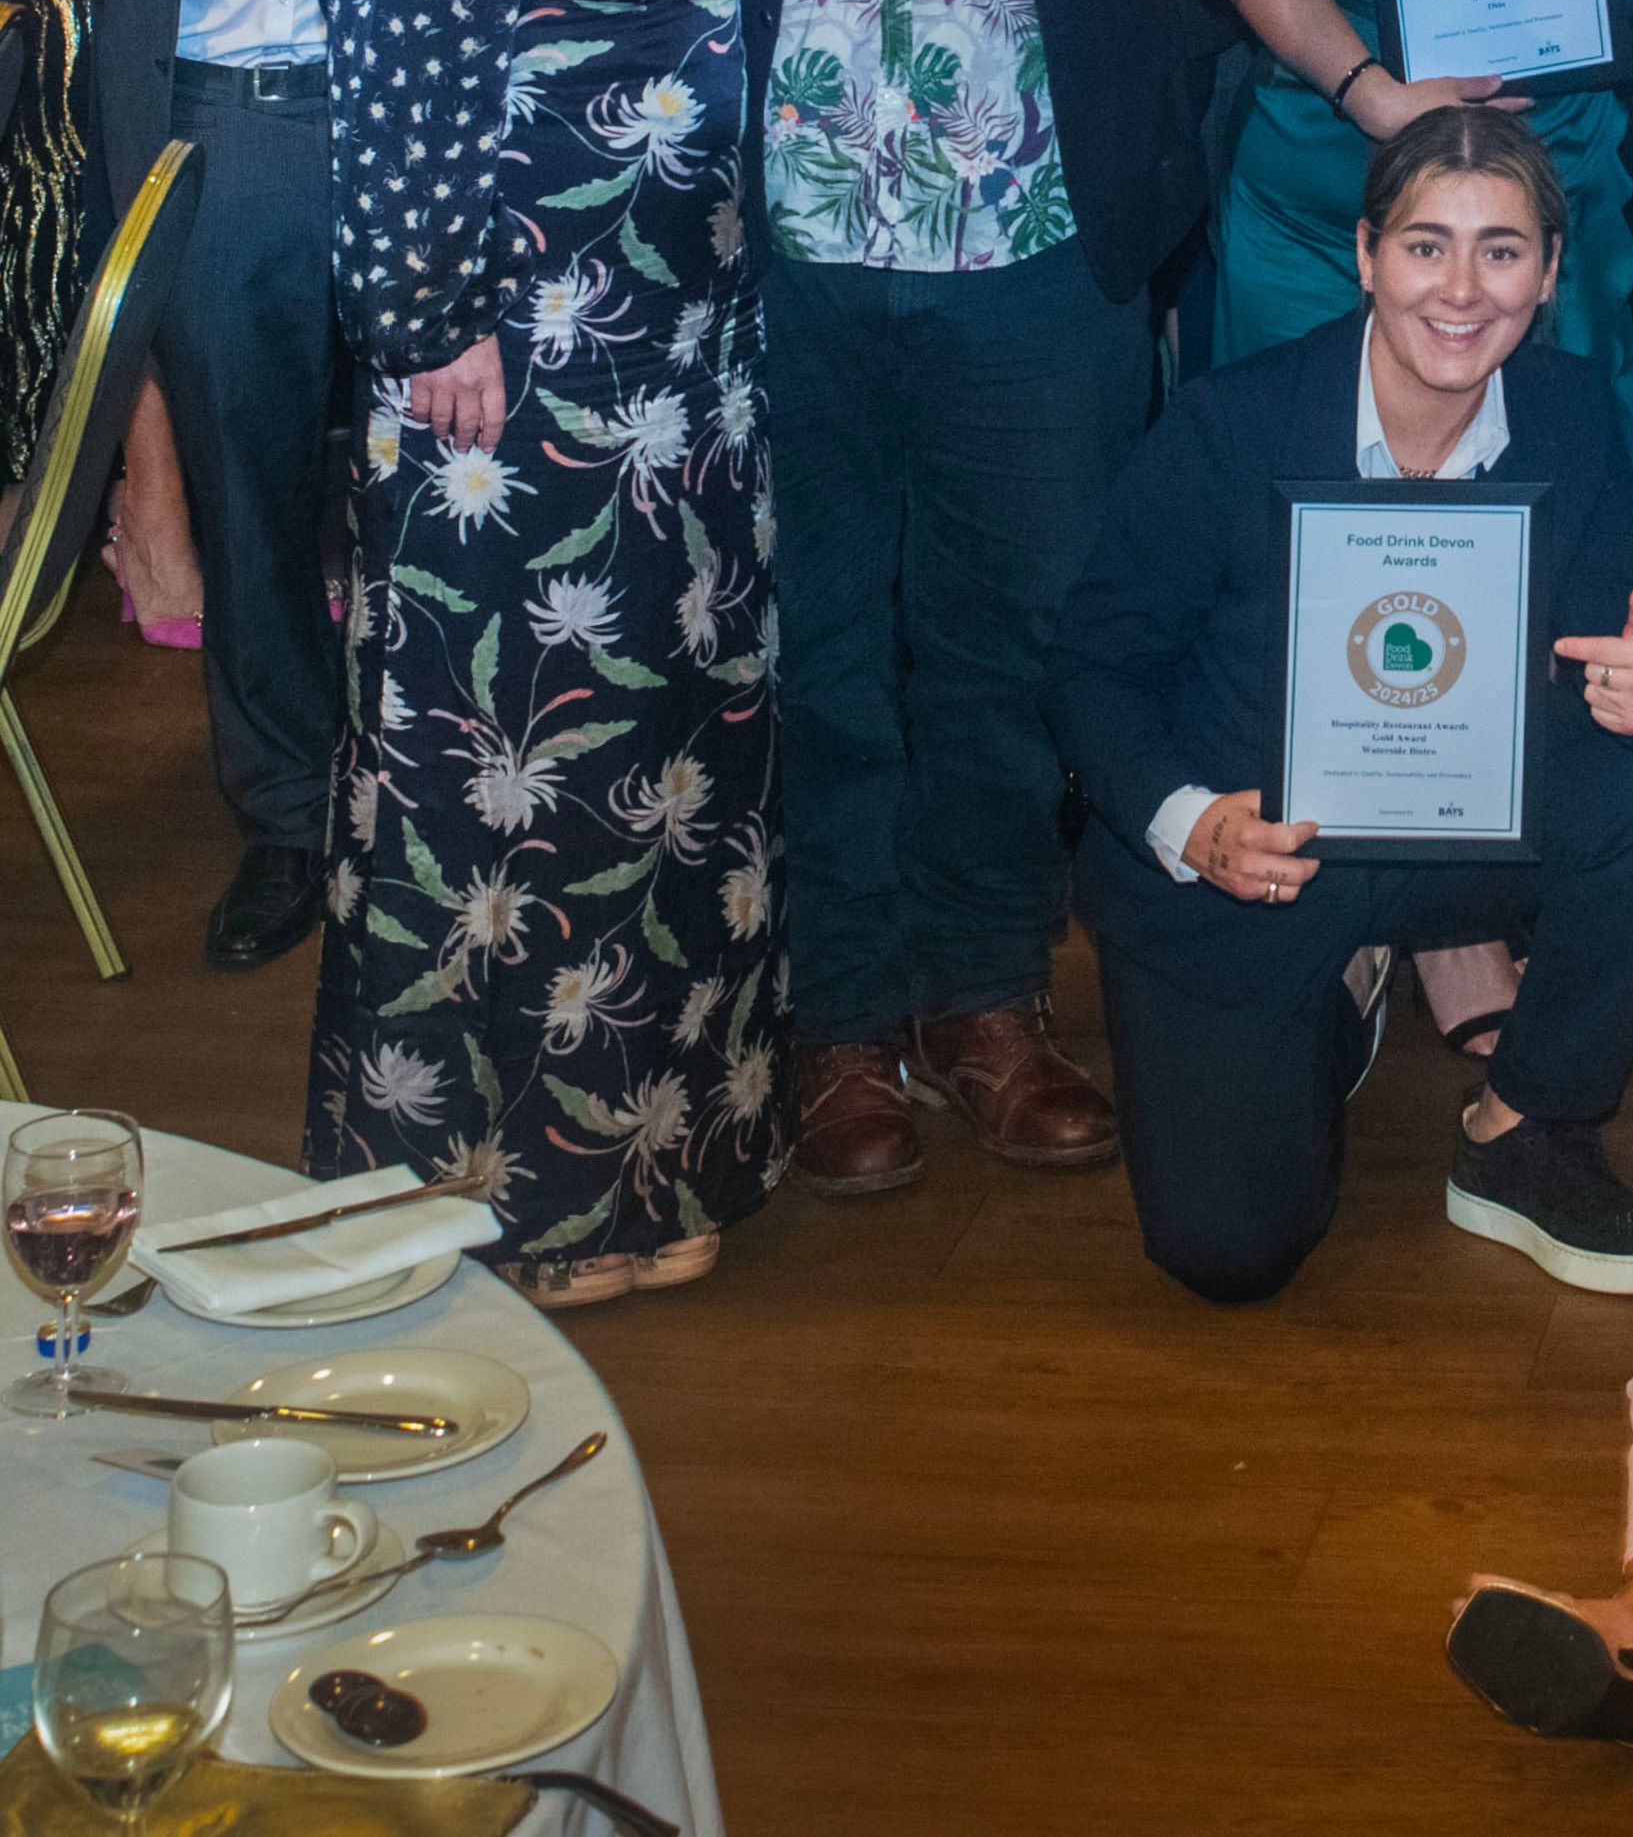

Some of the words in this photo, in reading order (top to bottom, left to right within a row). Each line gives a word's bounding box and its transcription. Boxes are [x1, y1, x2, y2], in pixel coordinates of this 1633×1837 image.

[1347, 533, 1382, 547] Food
[1386, 534, 1424, 548] Drink
[1429, 535, 1474, 548] Devon
[1382, 554, 1437, 567] Awards
[1376, 594, 1440, 618] GOLD
[1368, 682, 1439, 705] 2024/25
[1331, 719, 1379, 730] Hospitality
[1382, 720, 1431, 731] Restaurant
[1434, 721, 1469, 732] Awards
[1371, 733, 1394, 742] Gold
[1397, 733, 1427, 742] Award
[1438, 807, 1464, 817] BAYS
